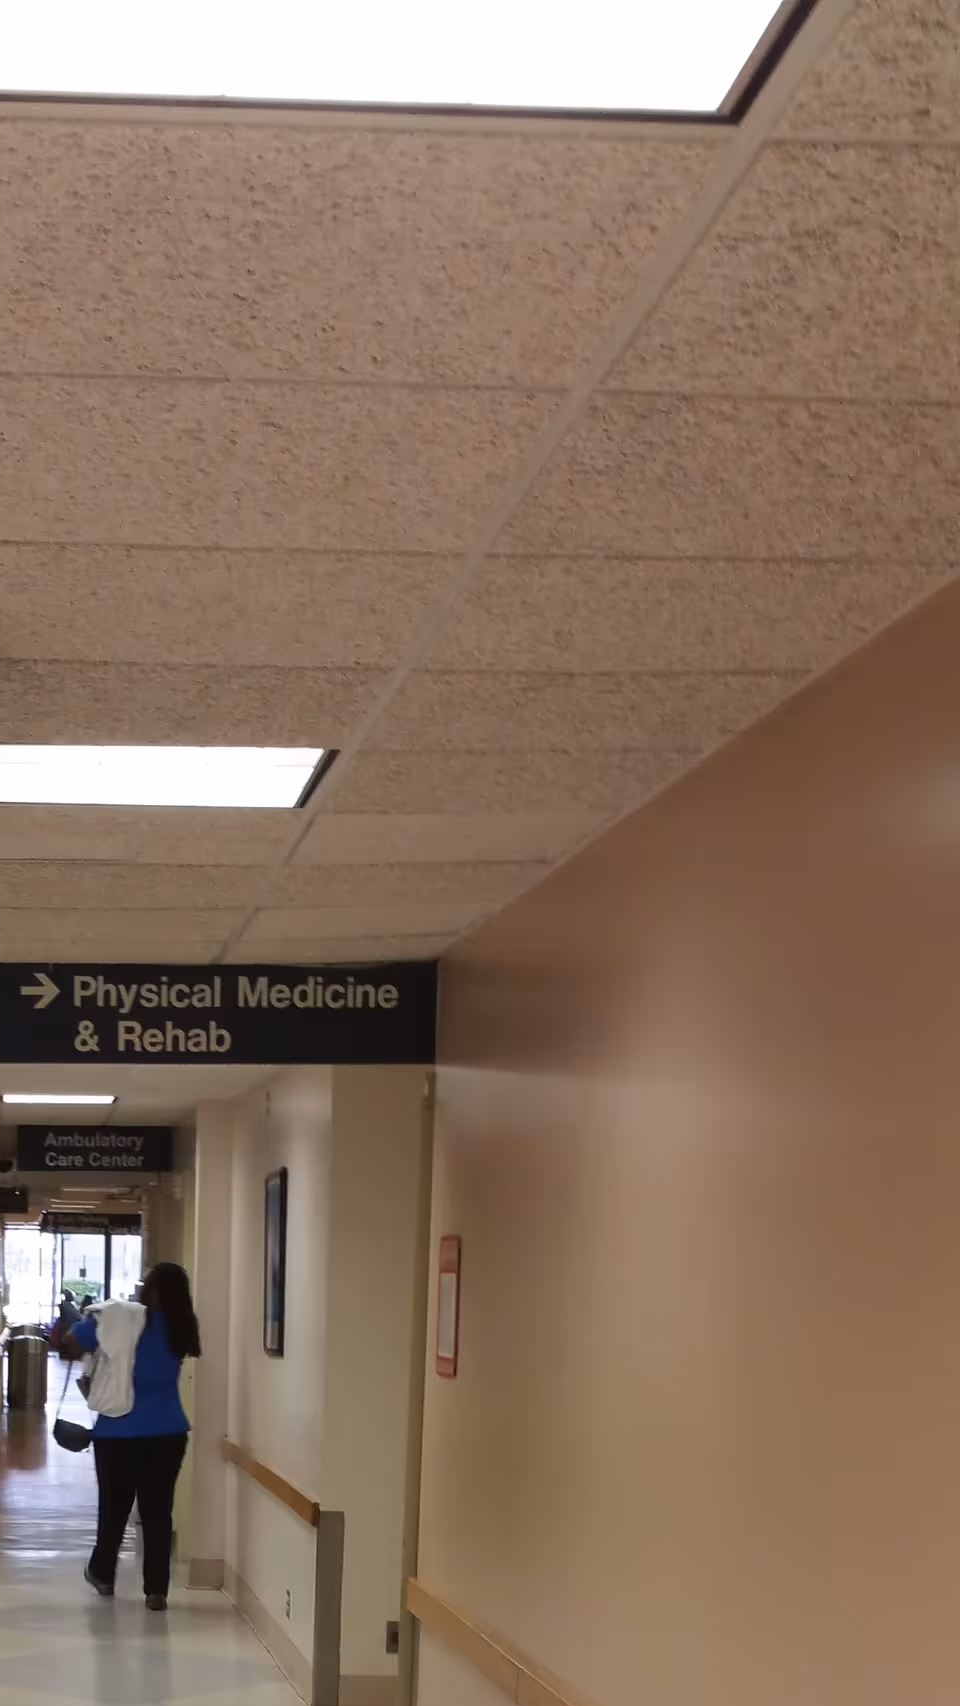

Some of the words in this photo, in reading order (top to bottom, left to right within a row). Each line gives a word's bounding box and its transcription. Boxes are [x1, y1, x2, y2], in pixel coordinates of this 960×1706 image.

[73, 975, 221, 1013] Physical
[238, 975, 399, 1009] Medicine
[74, 1020, 100, 1053] &
[117, 1020, 231, 1053] Rehab
[44, 1131, 144, 1151] Ambulatory
[45, 1152, 84, 1167] Care
[89, 1152, 144, 1168] Center
